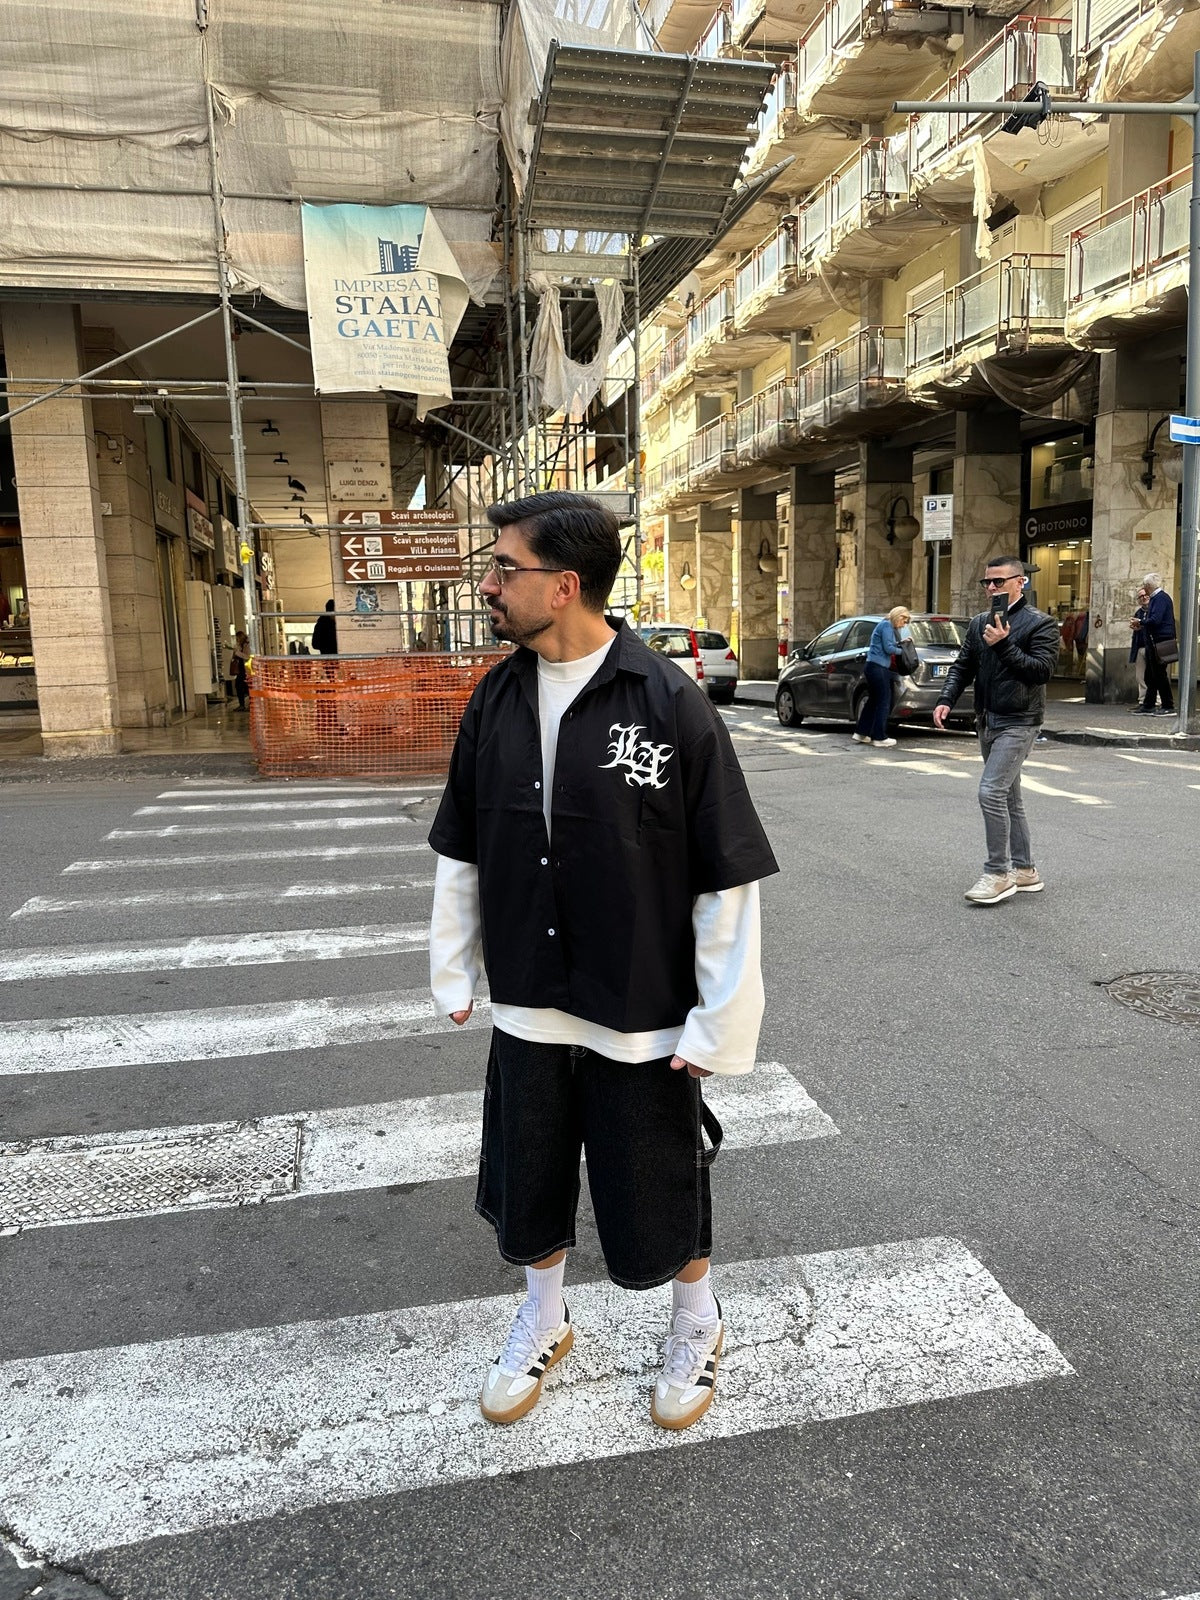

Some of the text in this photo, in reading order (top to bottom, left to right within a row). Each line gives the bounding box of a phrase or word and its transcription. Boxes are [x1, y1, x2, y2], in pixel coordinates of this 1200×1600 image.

[334, 278, 422, 293] IMPRESA
[337, 318, 441, 343] GAETA
[358, 479, 379, 487] DENZA
[391, 511, 455, 521] Scavi archeologici
[1025, 517, 1088, 538] GIROTONDO
[393, 535, 456, 545] Scavi archeologici
[410, 546, 457, 555] Villa Arianna
[387, 565, 413, 574] Reggia
[424, 564, 460, 573] Quisisana
